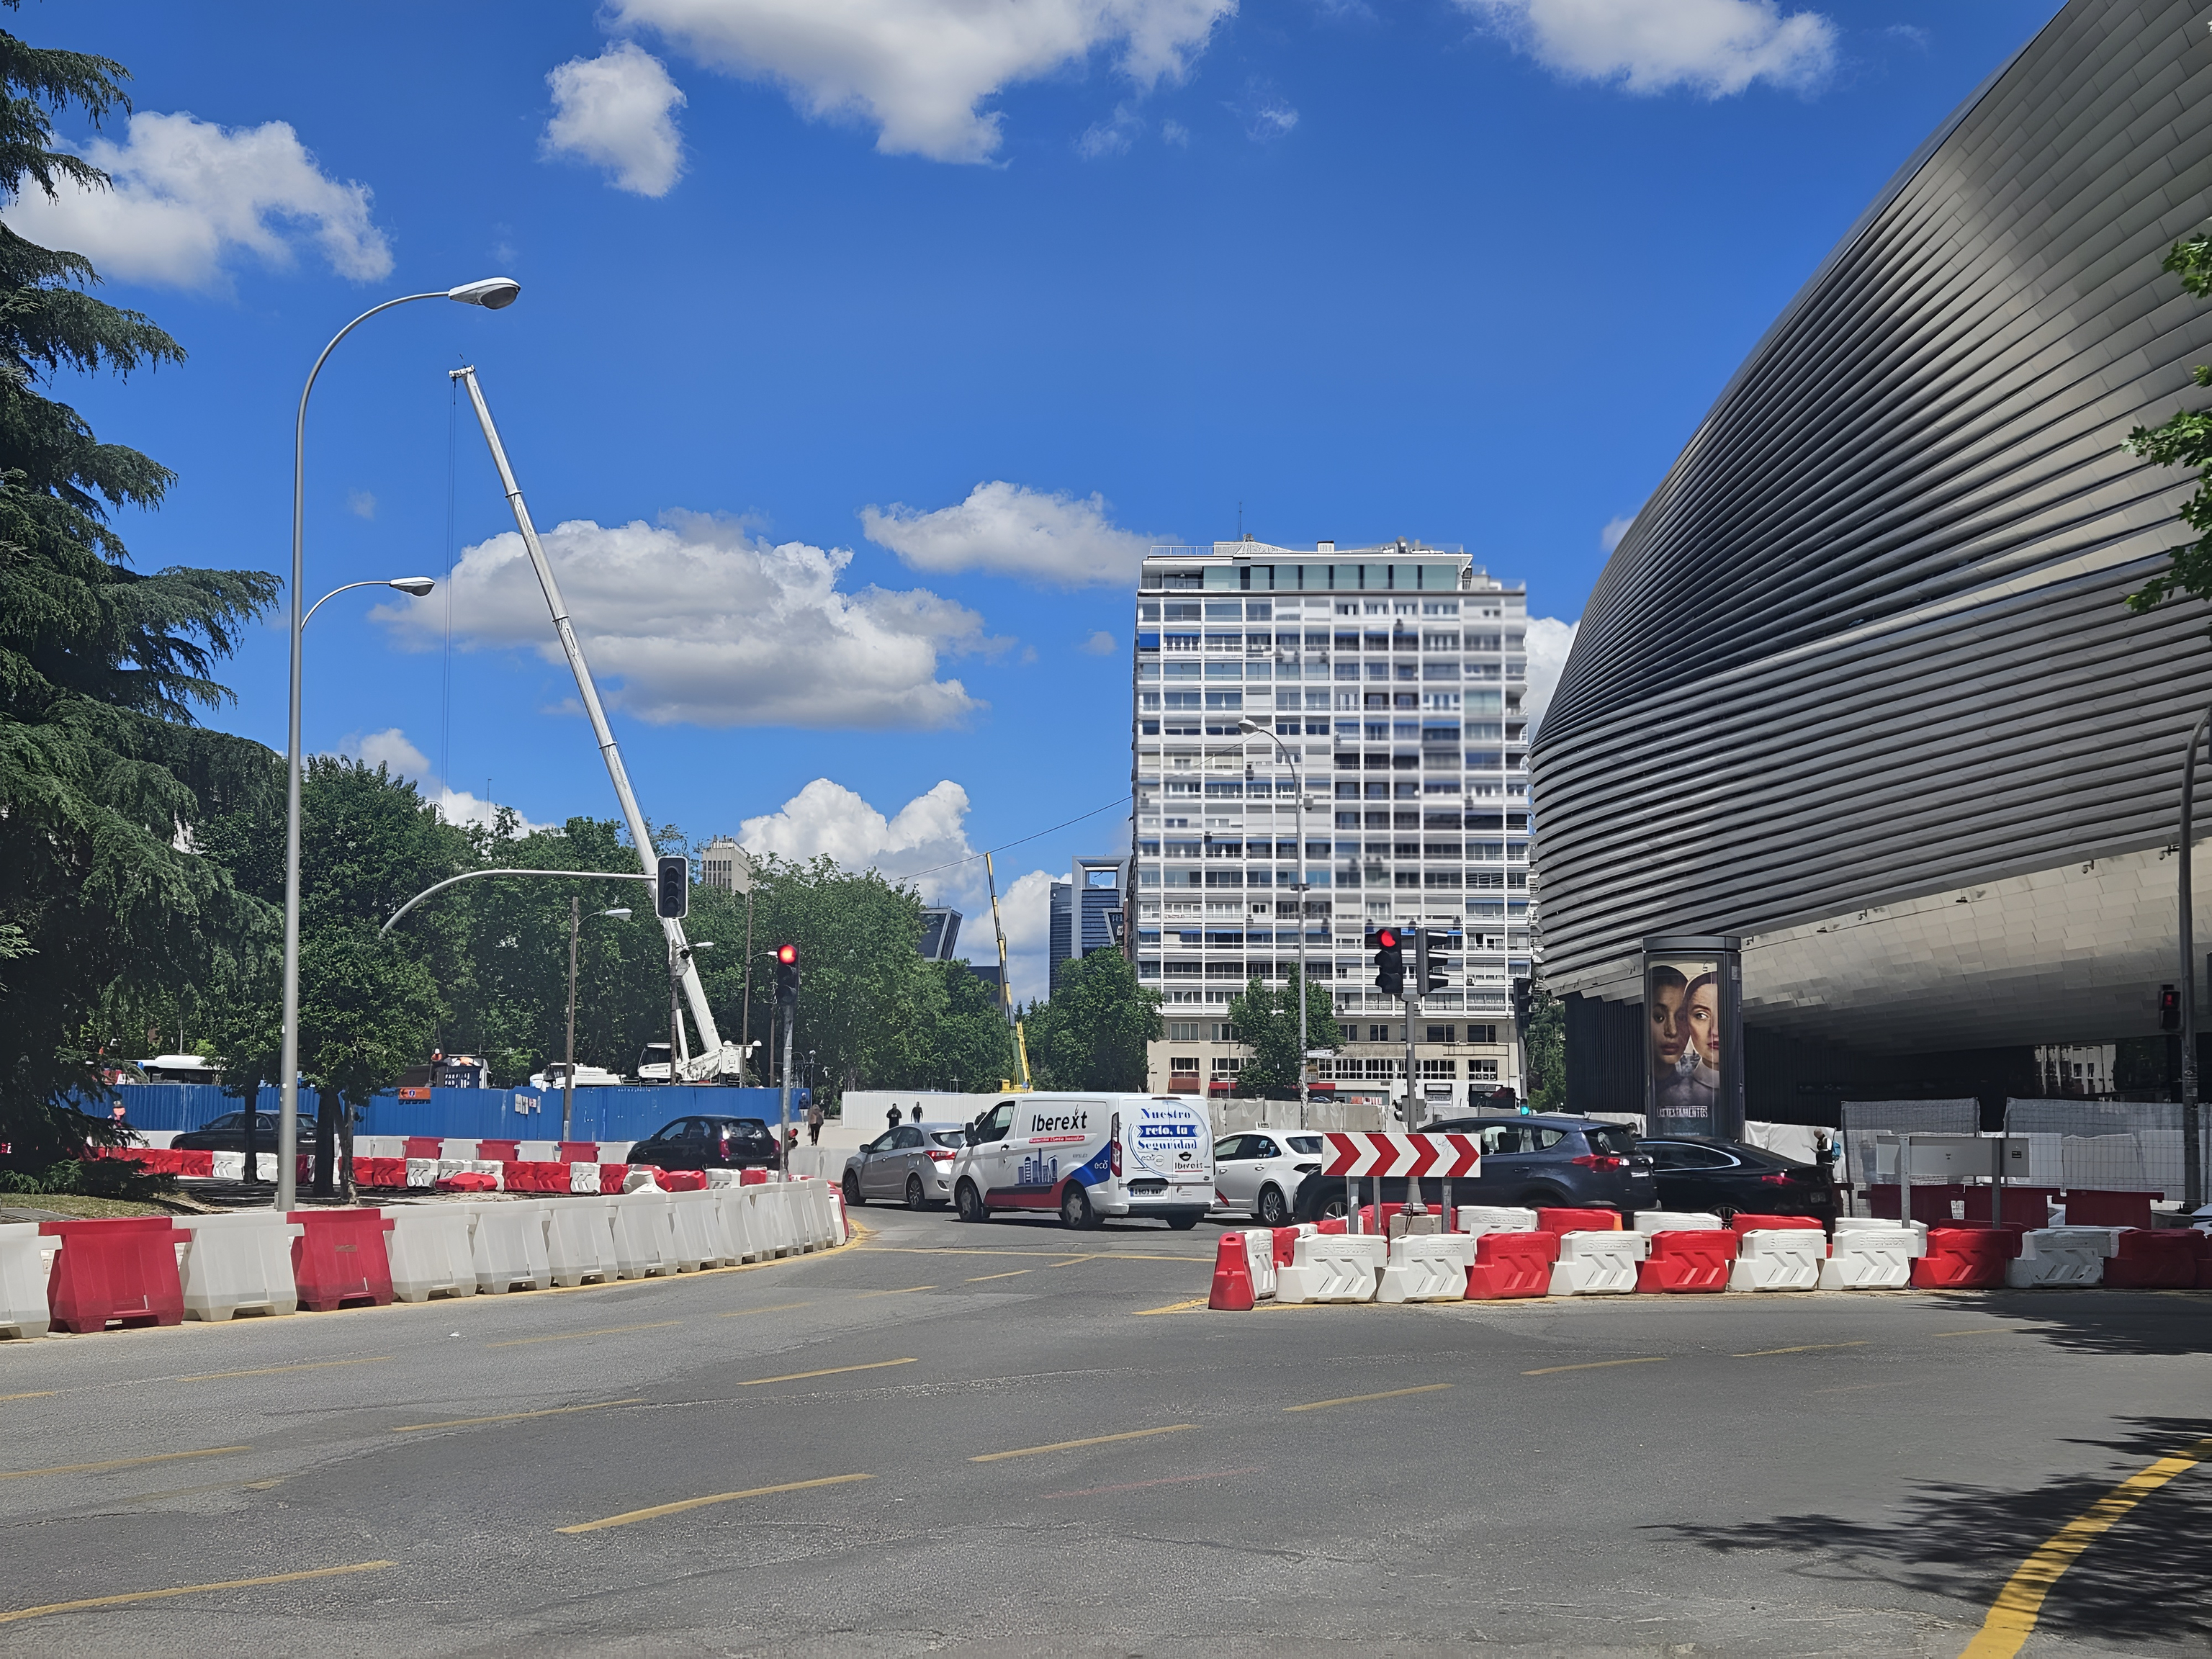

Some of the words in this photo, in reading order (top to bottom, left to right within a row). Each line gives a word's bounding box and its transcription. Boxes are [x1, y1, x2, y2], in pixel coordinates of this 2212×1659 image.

[1141, 1107, 1191, 1120] Nuestro
[1031, 1110, 1088, 1133] Iberext
[1177, 1125, 1188, 1136] tu
[1137, 1139, 1197, 1151] Seguridad
